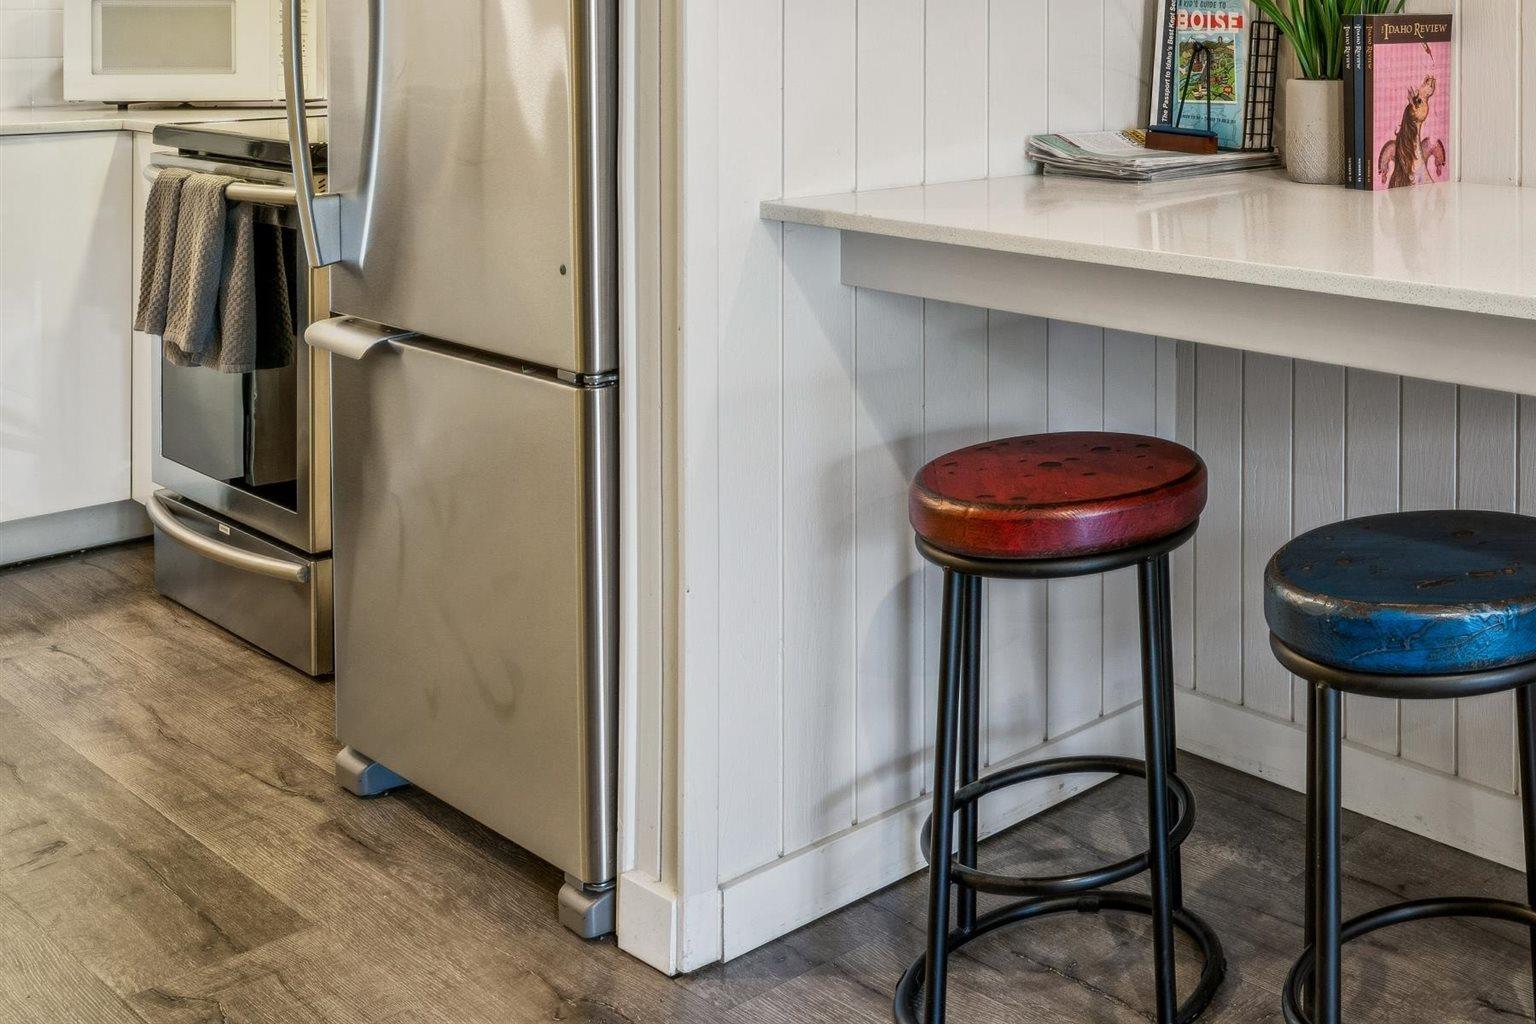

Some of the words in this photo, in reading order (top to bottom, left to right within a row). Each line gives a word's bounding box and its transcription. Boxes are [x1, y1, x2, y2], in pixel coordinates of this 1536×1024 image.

[1200, 0, 1216, 9] GUIDE
[1219, 0, 1227, 10] TO
[1177, 9, 1239, 33] BOISE
[1383, 23, 1413, 40] IDAHO
[1413, 22, 1448, 39] REVIEW
[1165, 71, 1171, 79] to
[1162, 79, 1170, 109] Passport
